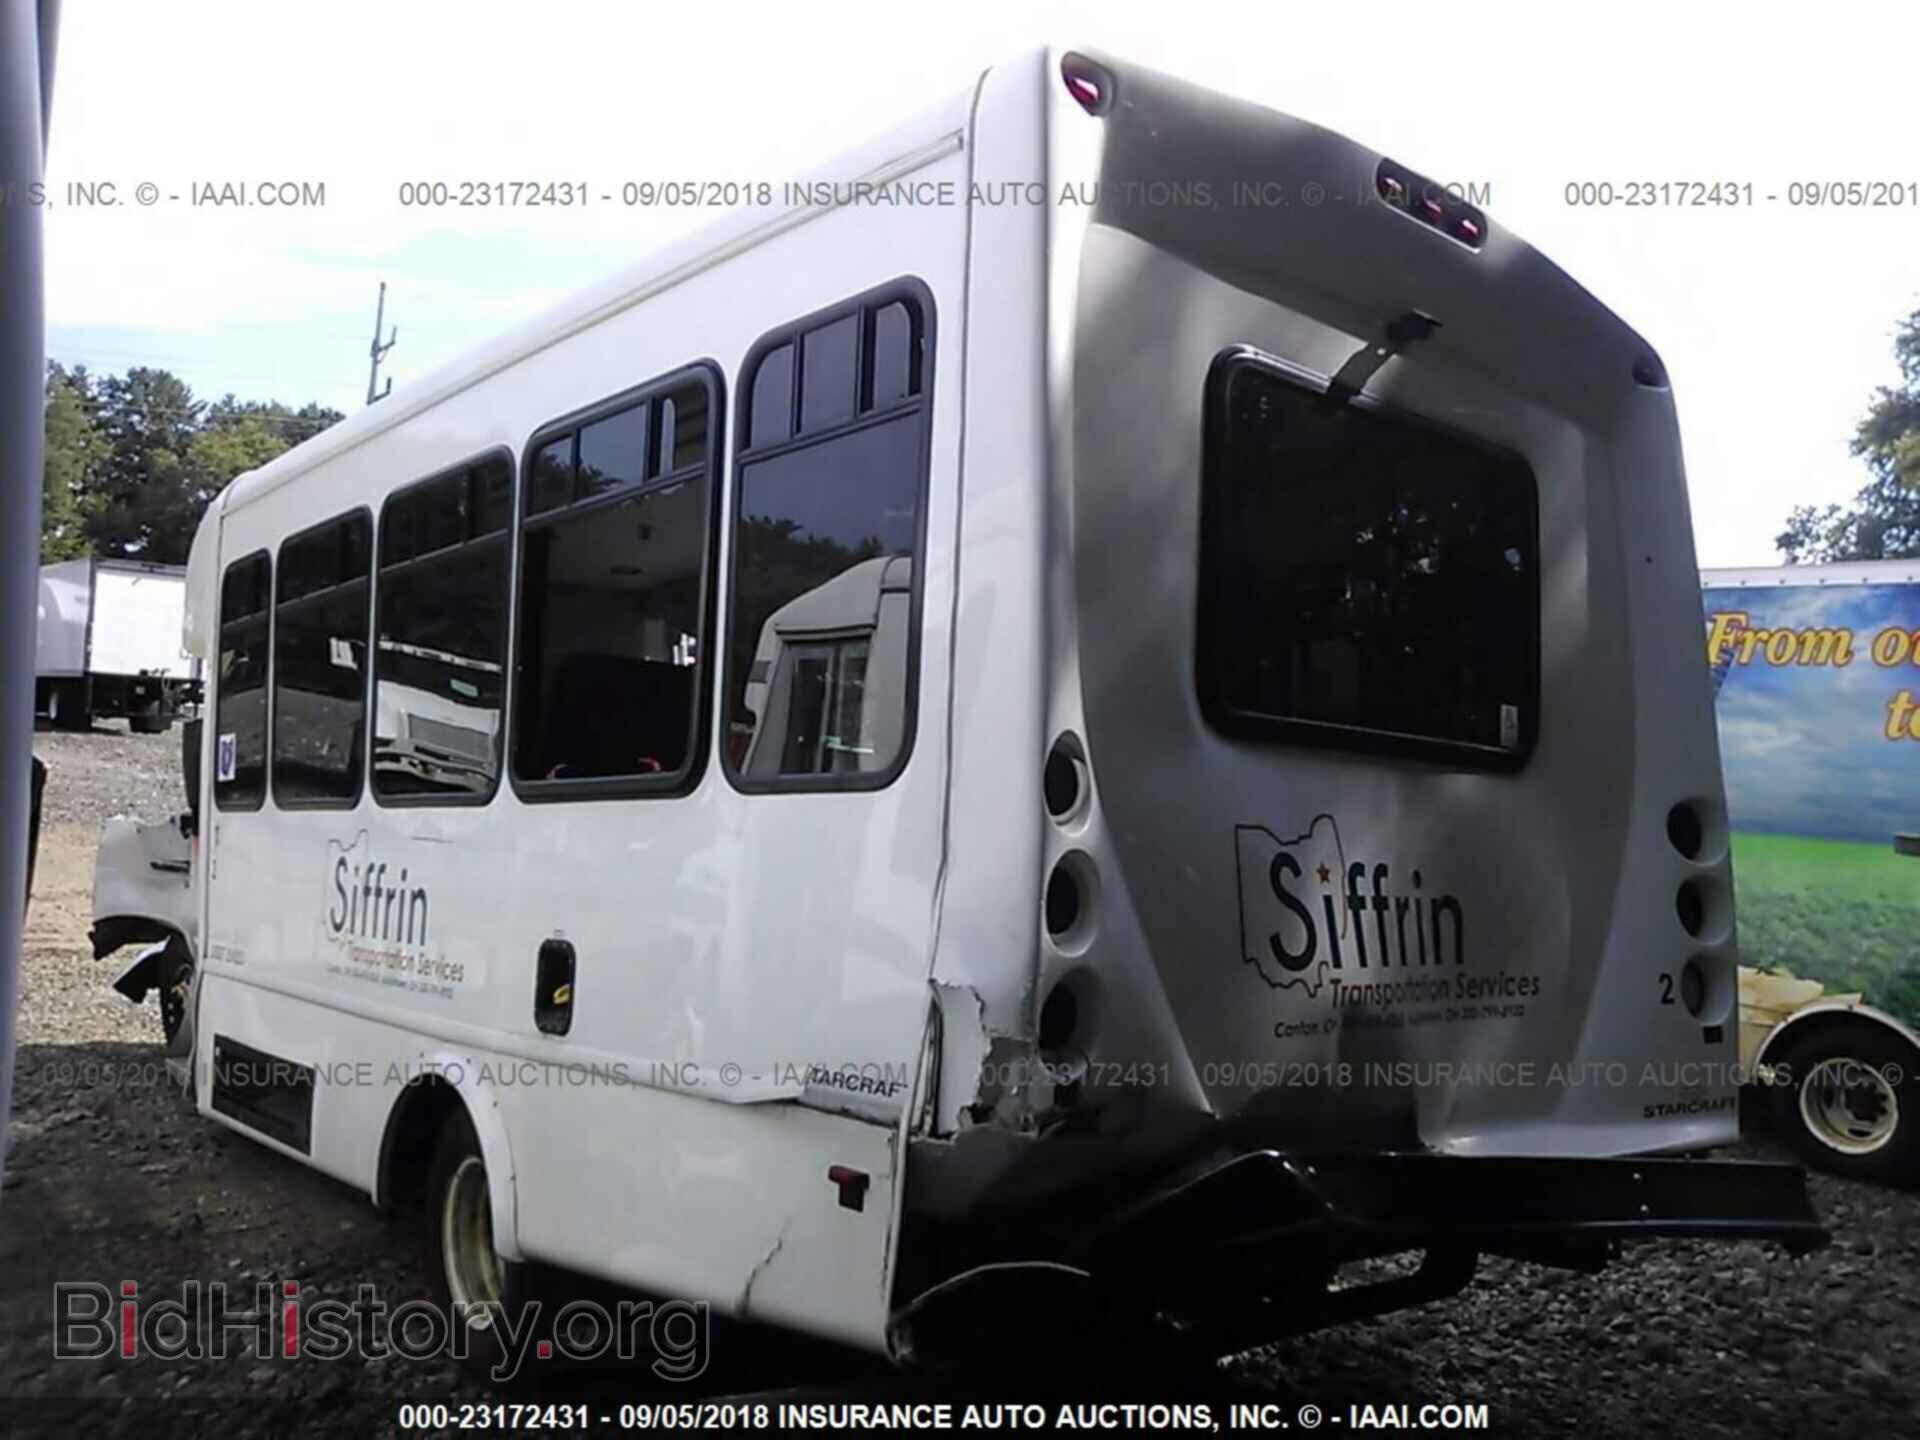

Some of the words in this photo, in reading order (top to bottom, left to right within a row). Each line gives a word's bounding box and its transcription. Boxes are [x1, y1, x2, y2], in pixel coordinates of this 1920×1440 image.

[1706, 610, 1855, 668] From
[1872, 626, 1920, 668] o
[330, 856, 428, 946] Siffrin
[1268, 851, 1465, 972] Siffrin
[417, 951, 464, 982] Services
[1455, 969, 1541, 999] Services
[1658, 973, 1676, 1005] 2
[804, 1065, 909, 1098] TARCRAF
[1642, 1096, 1737, 1120] STARCRAFT
